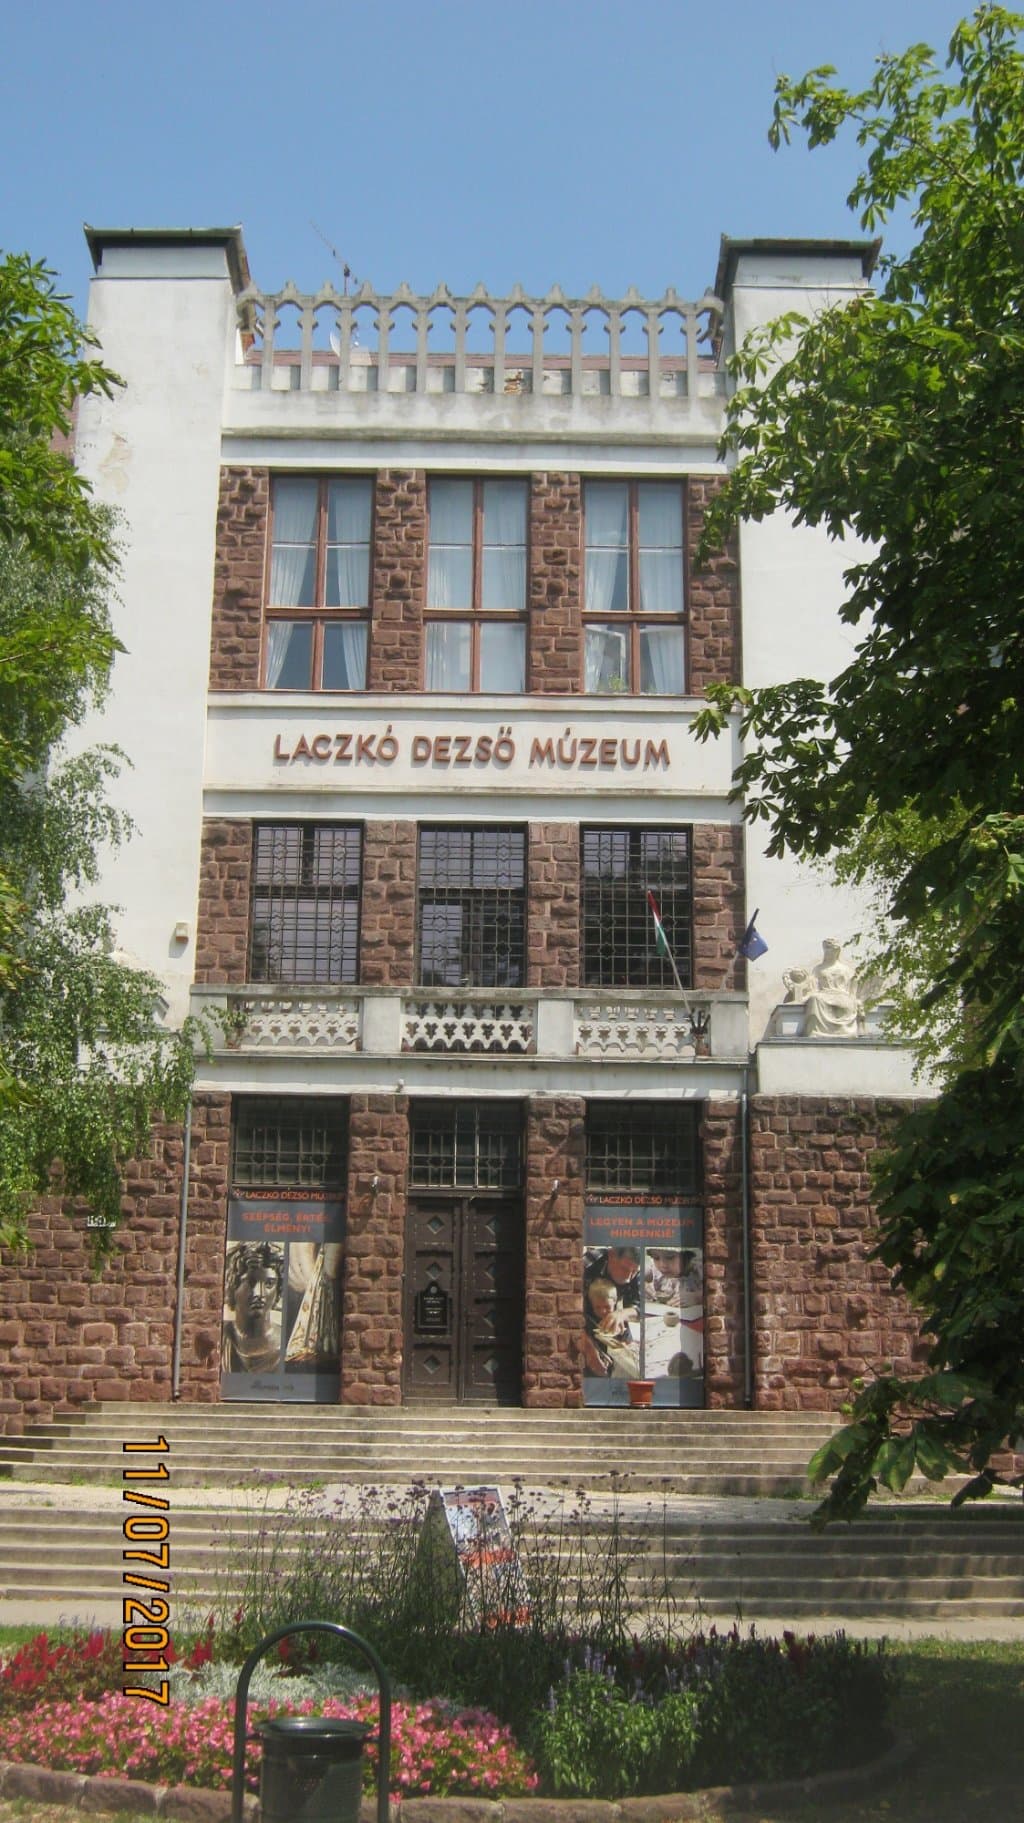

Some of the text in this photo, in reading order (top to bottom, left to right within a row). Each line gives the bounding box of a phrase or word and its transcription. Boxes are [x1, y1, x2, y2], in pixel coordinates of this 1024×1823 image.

[275, 724, 671, 766] LACZKÓ DEZSŐ MÚZEUM
[636, 1216, 645, 1227] A
